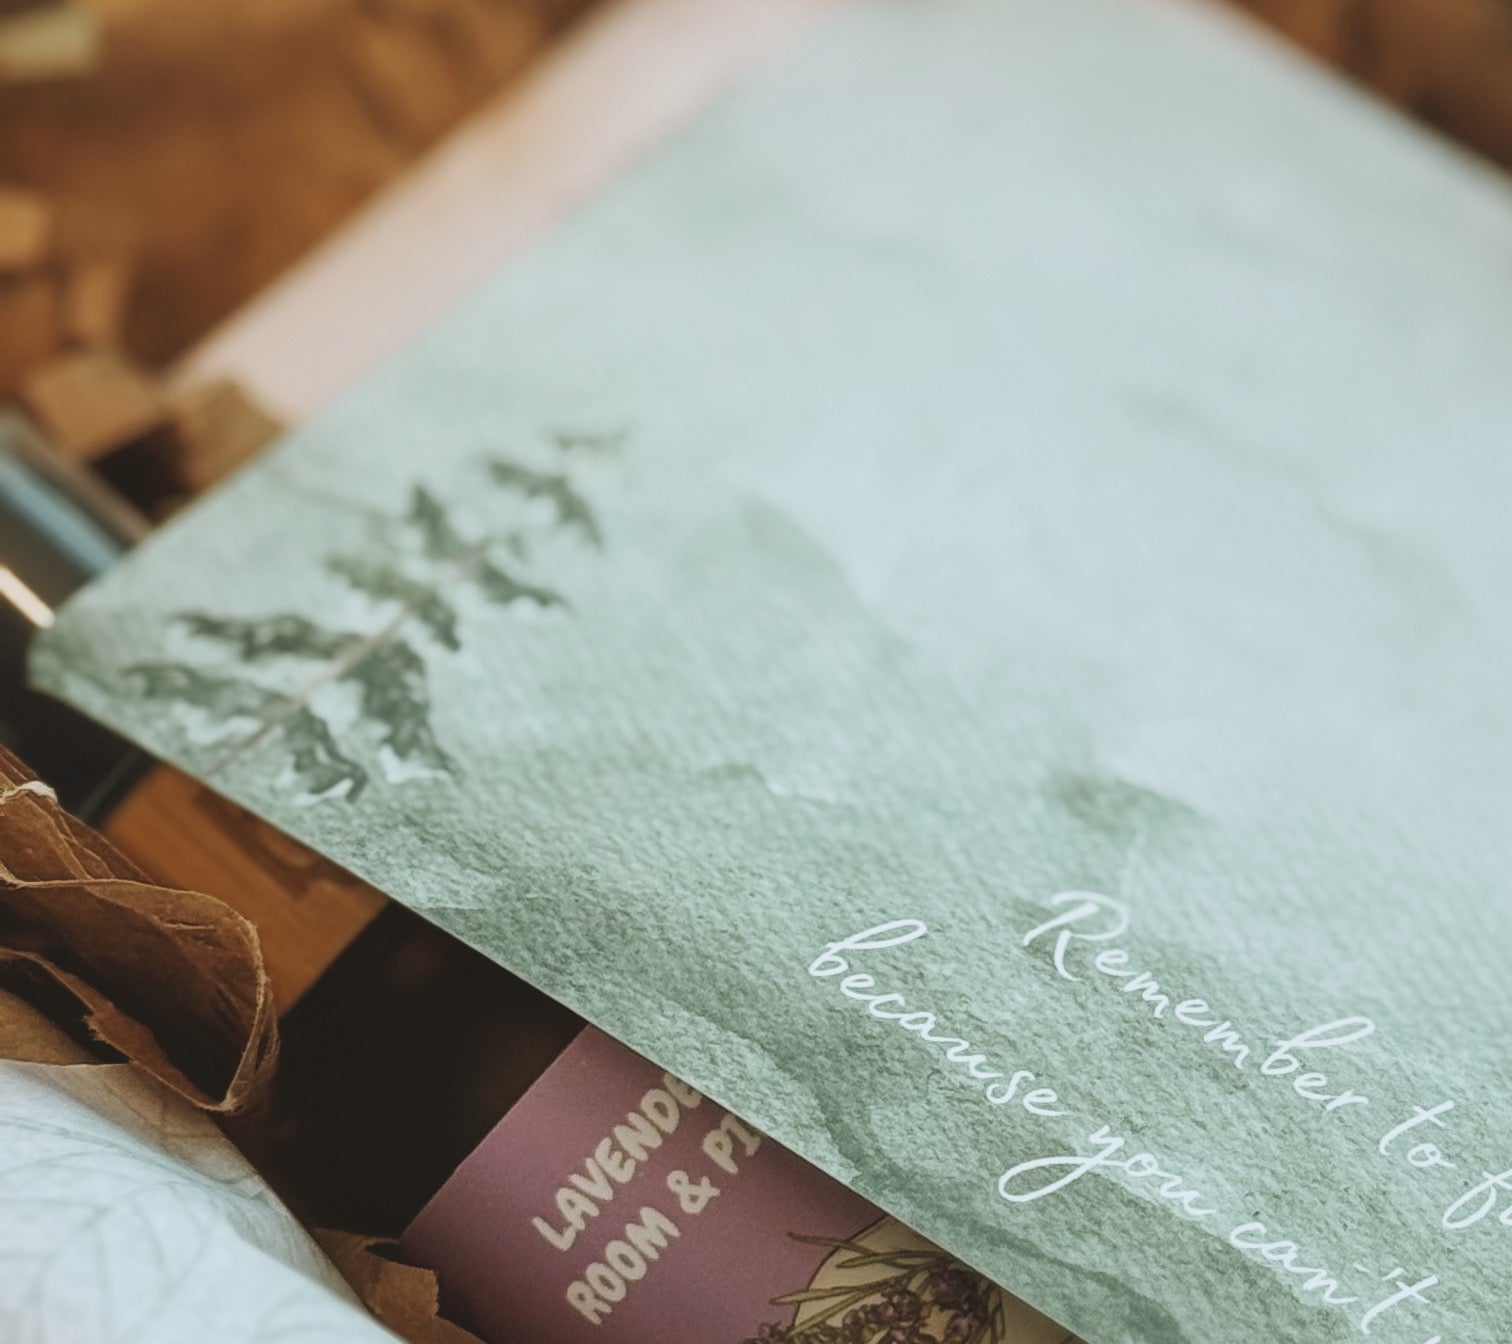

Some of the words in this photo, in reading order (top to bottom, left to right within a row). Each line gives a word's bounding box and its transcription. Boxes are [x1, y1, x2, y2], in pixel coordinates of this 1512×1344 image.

[808, 918, 1074, 1117] because
[998, 1124, 1217, 1216] you
[1229, 1221, 1439, 1335] can't
[1022, 889, 1375, 1113] Remember
[1379, 1100, 1457, 1169] to
[565, 1206, 681, 1326] ROOM
[666, 1169, 721, 1215] &
